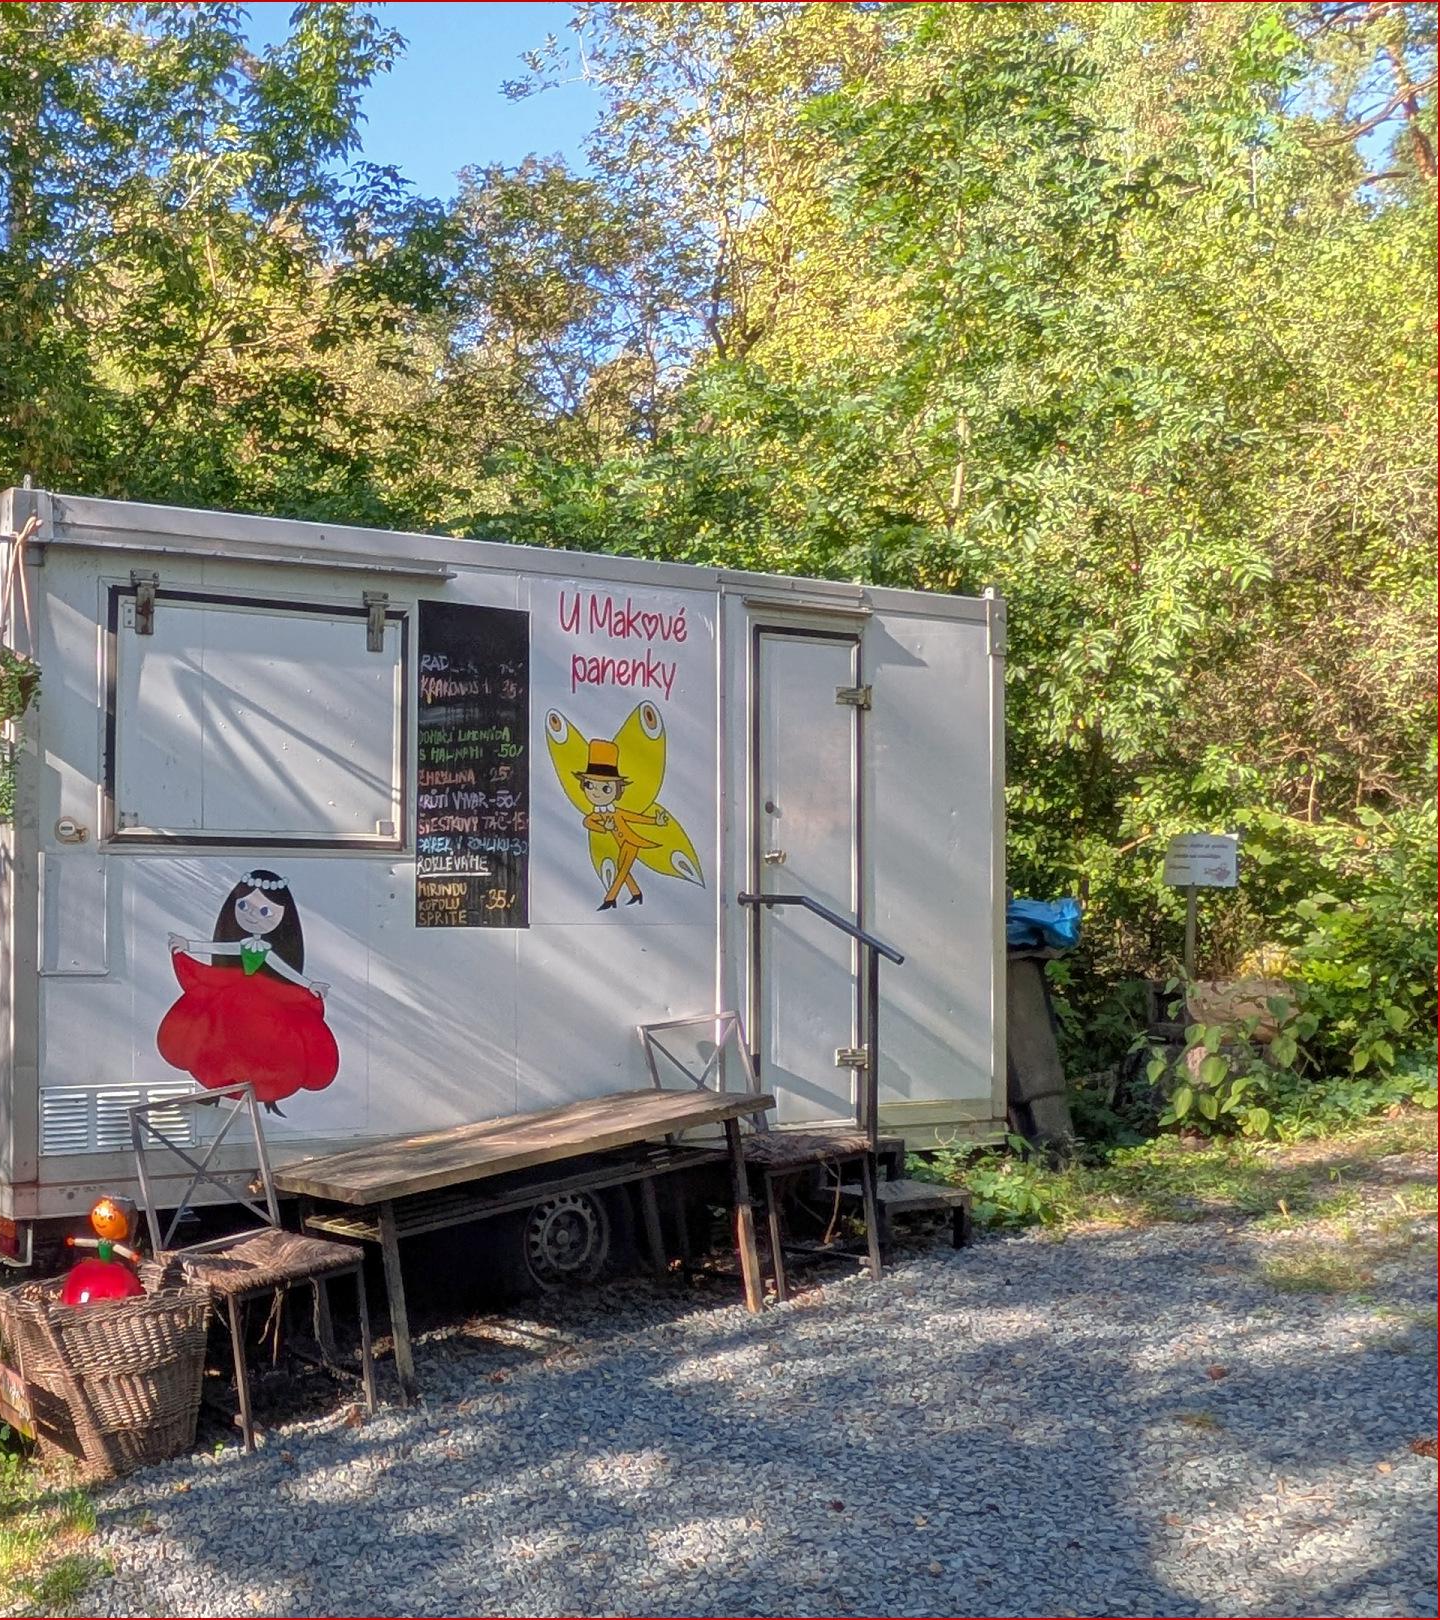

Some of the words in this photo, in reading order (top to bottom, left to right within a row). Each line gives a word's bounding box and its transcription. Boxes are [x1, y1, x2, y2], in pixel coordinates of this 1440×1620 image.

[560, 591, 580, 634] U
[590, 594, 687, 642] Makové
[572, 648, 677, 700] panenky
[419, 748, 426, 760] S
[452, 784, 489, 810] VÝVAR
[417, 881, 467, 897] MIRINDU
[418, 910, 467, 926] SPRITE
